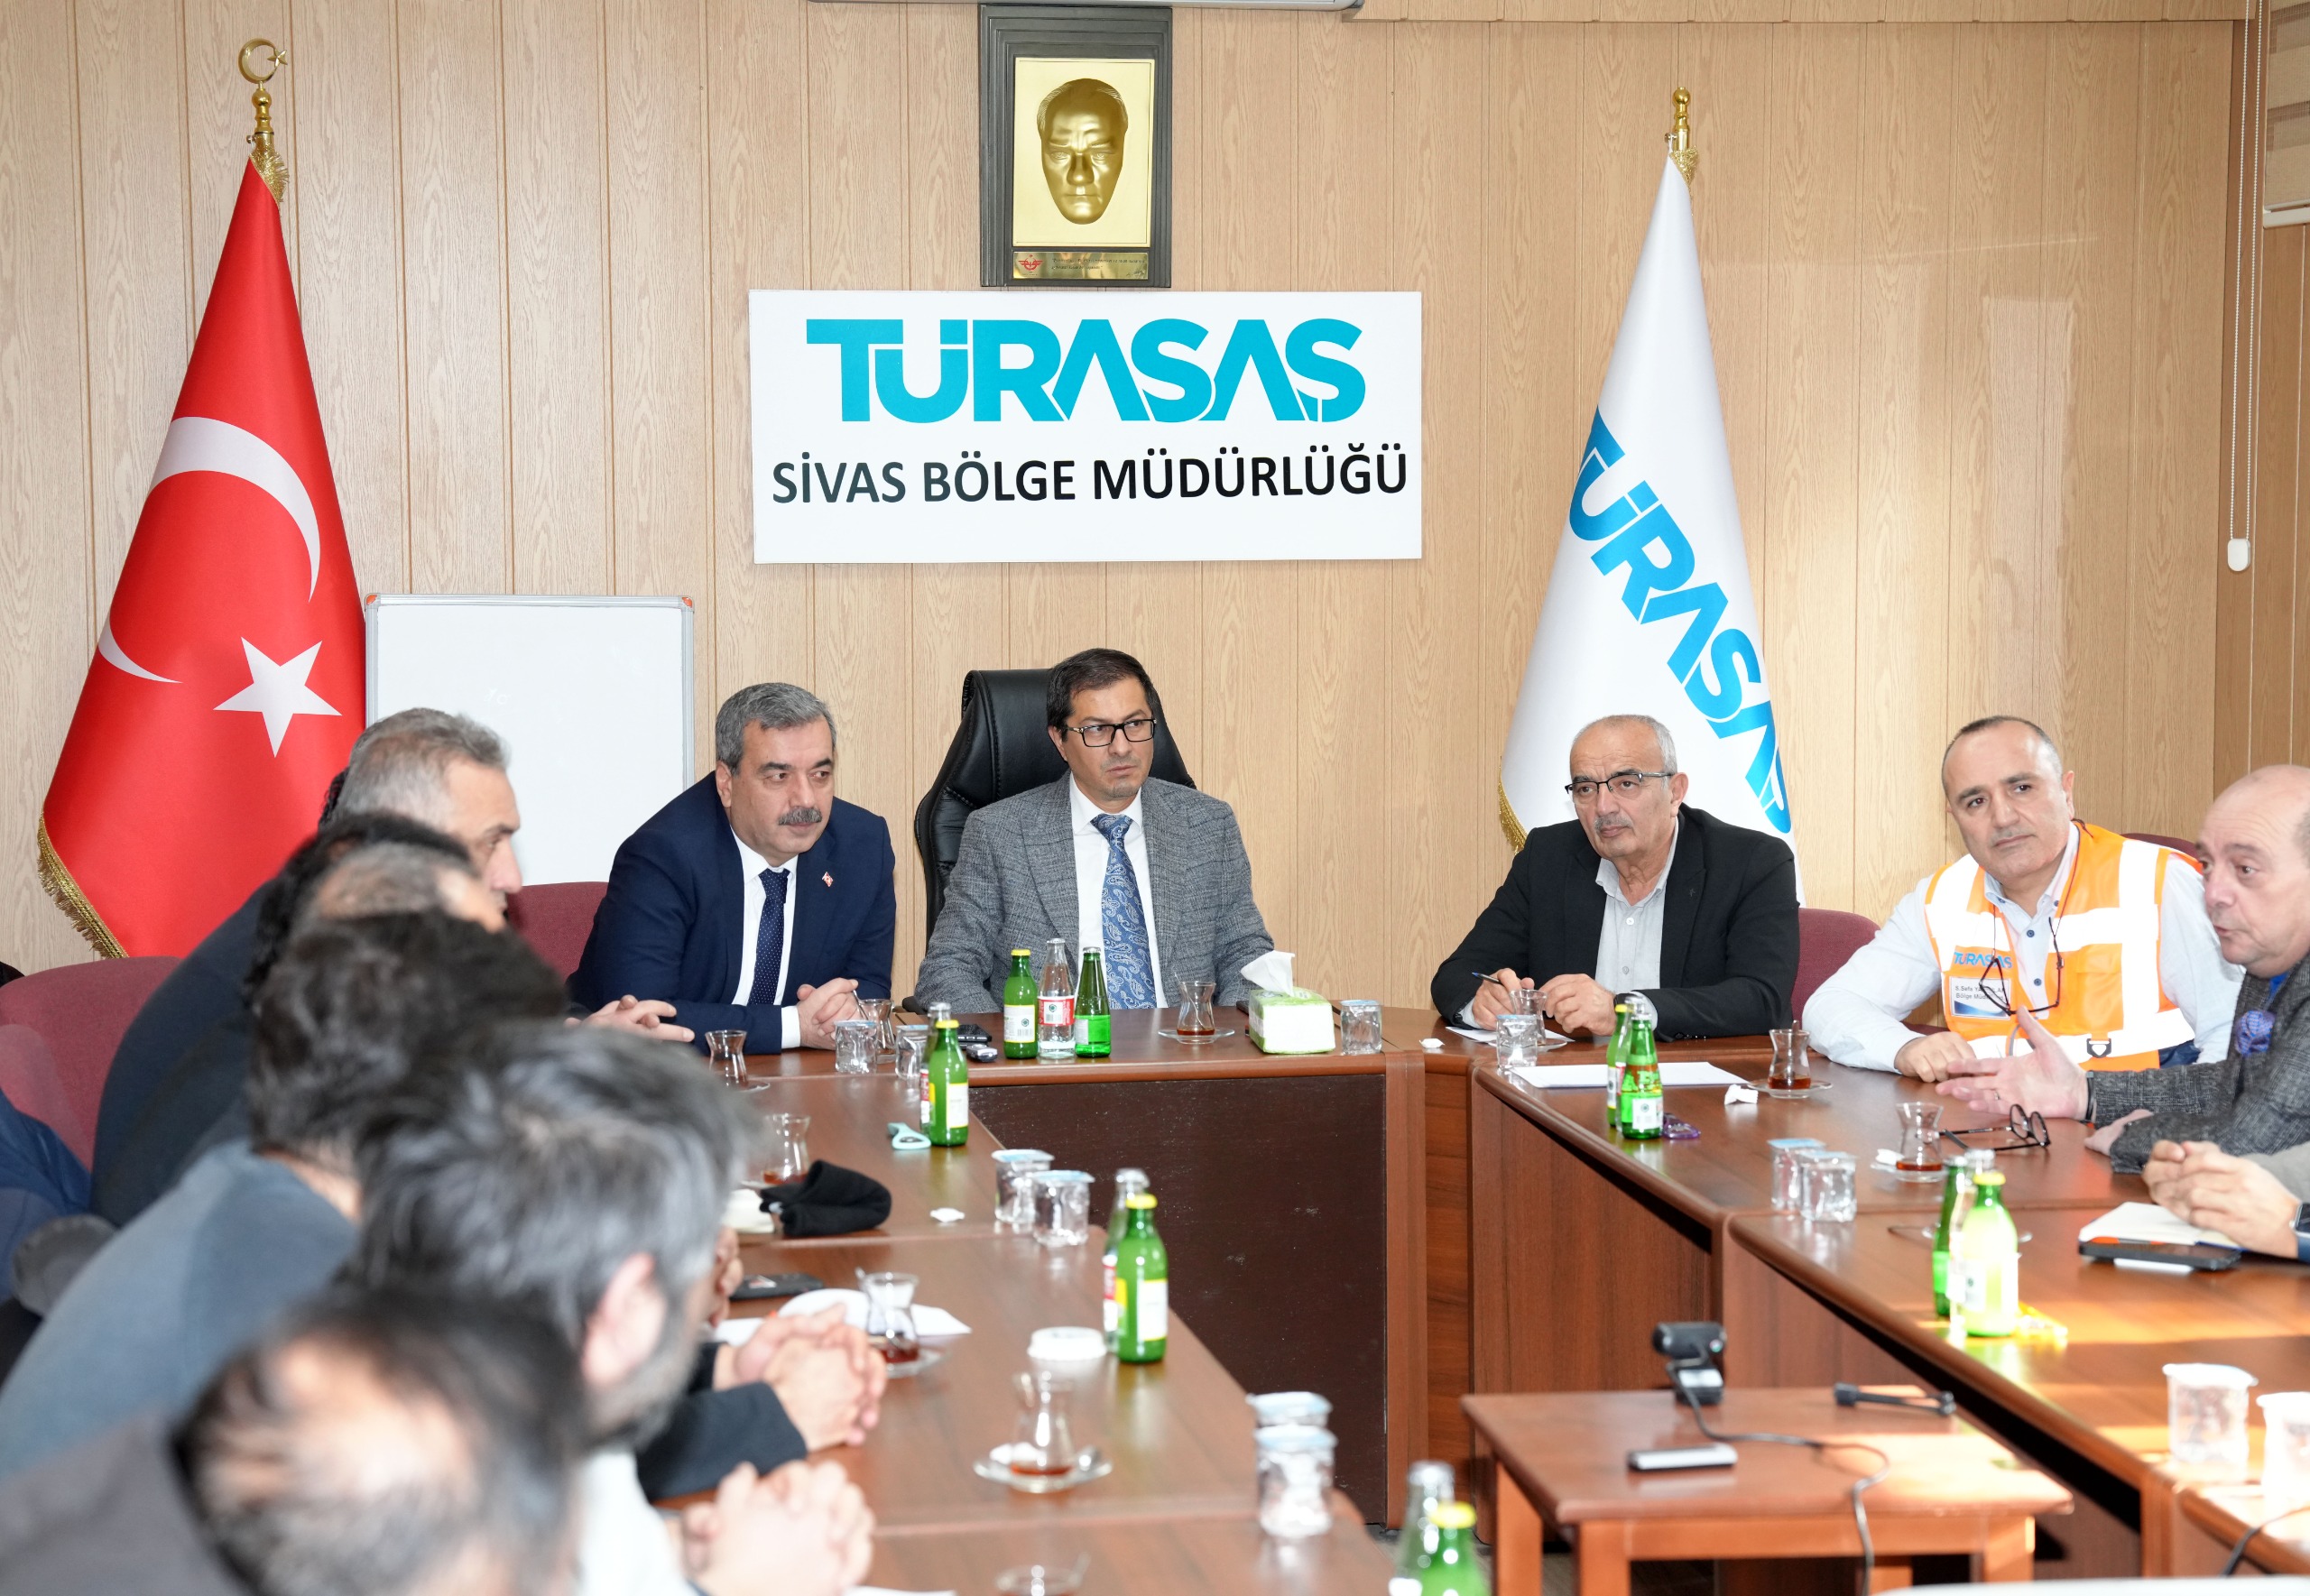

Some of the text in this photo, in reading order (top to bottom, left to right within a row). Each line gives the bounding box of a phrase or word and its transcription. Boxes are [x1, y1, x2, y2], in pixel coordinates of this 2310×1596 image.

[772, 442, 1407, 503] SİVAS BÖLGE MÜDÜRLÜĞÜ
